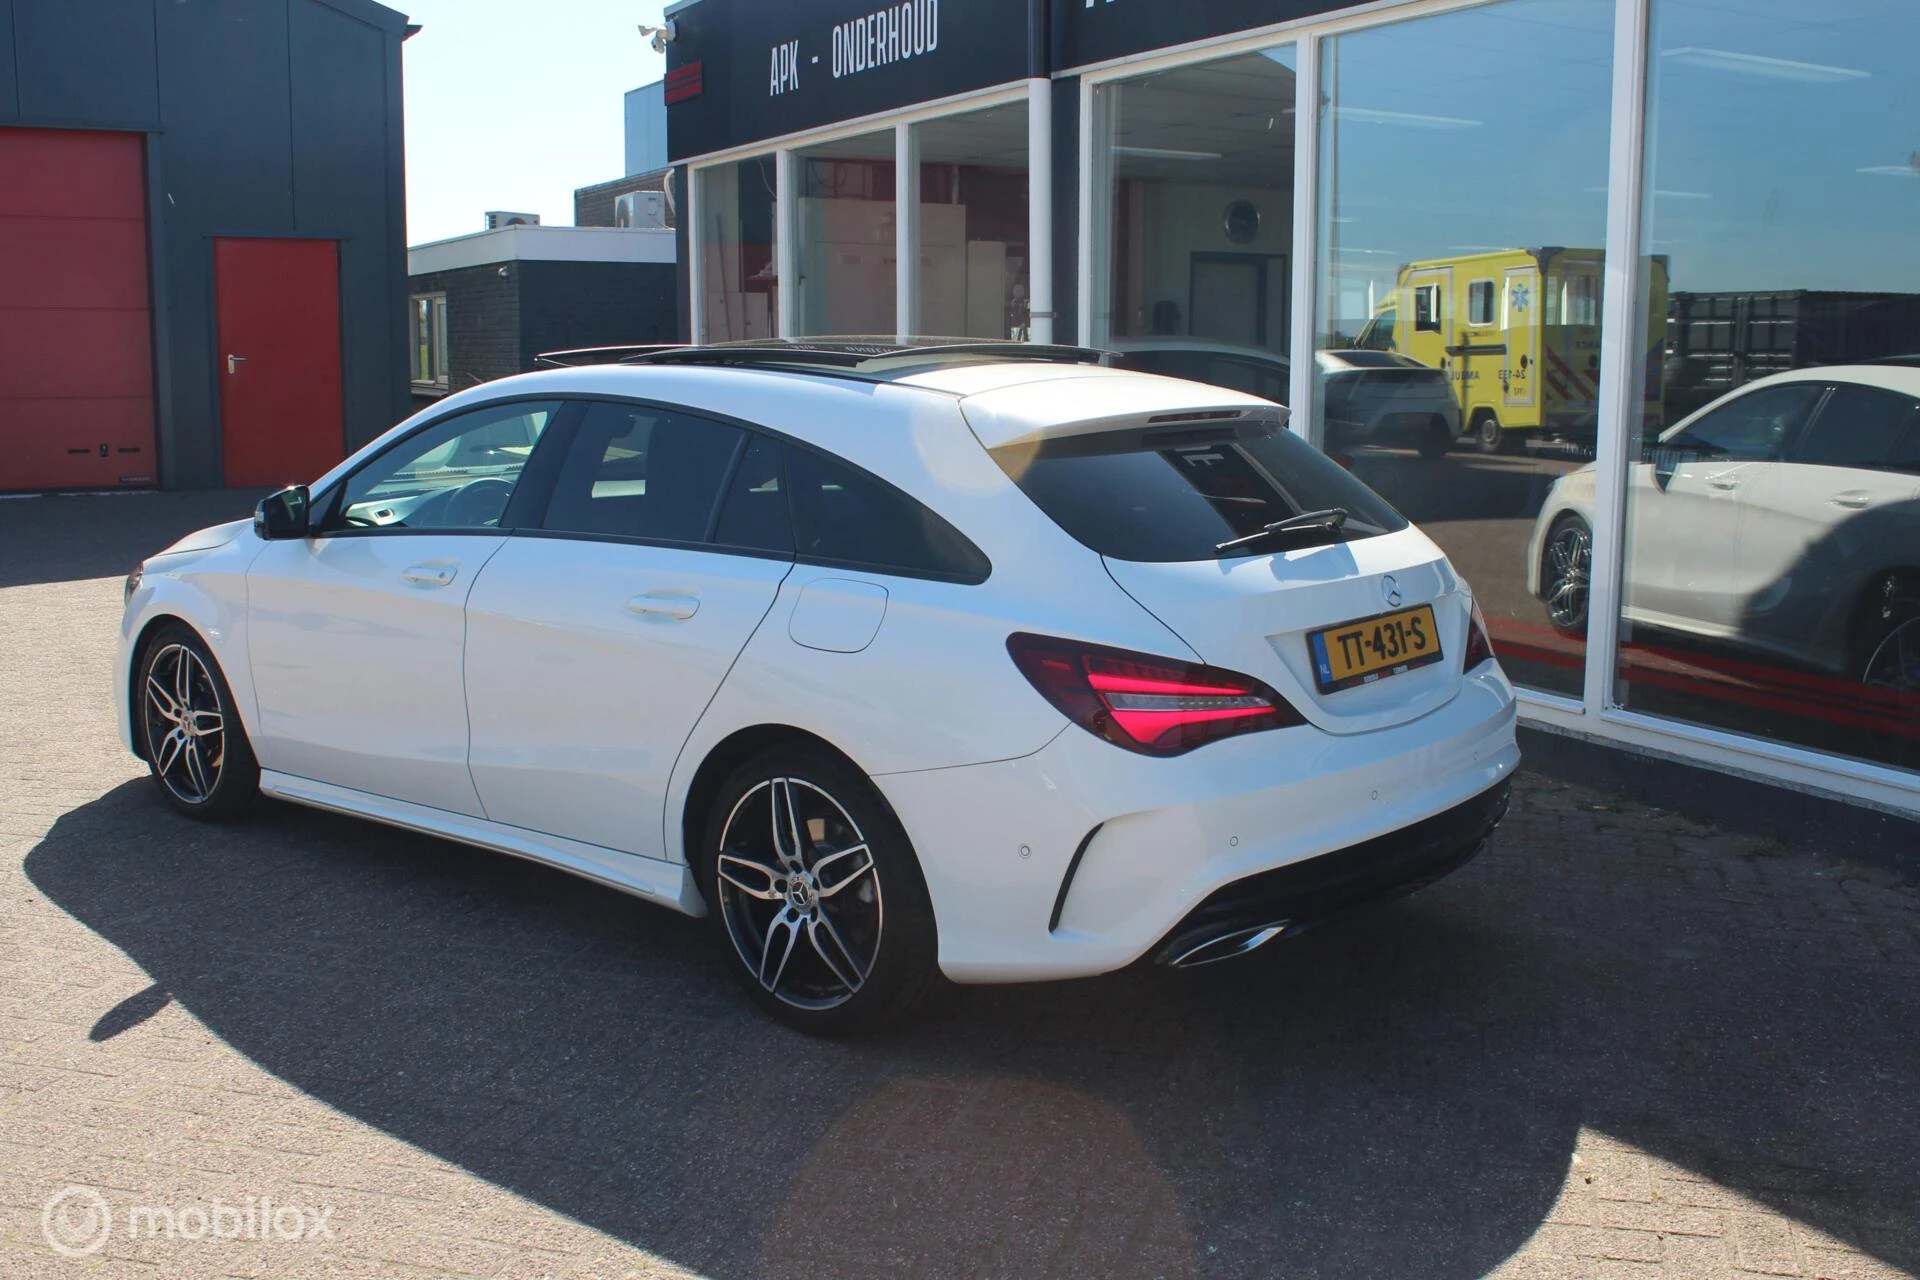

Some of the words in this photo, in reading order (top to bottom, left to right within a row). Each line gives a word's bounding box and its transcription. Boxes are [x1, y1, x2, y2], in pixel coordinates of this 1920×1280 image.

[770, 40, 799, 96] APK
[811, 56, 819, 64] -
[832, 0, 938, 78] ONDERHOUD
[1320, 663, 1330, 674] NL
[1336, 616, 1427, 670] TT-431-S
